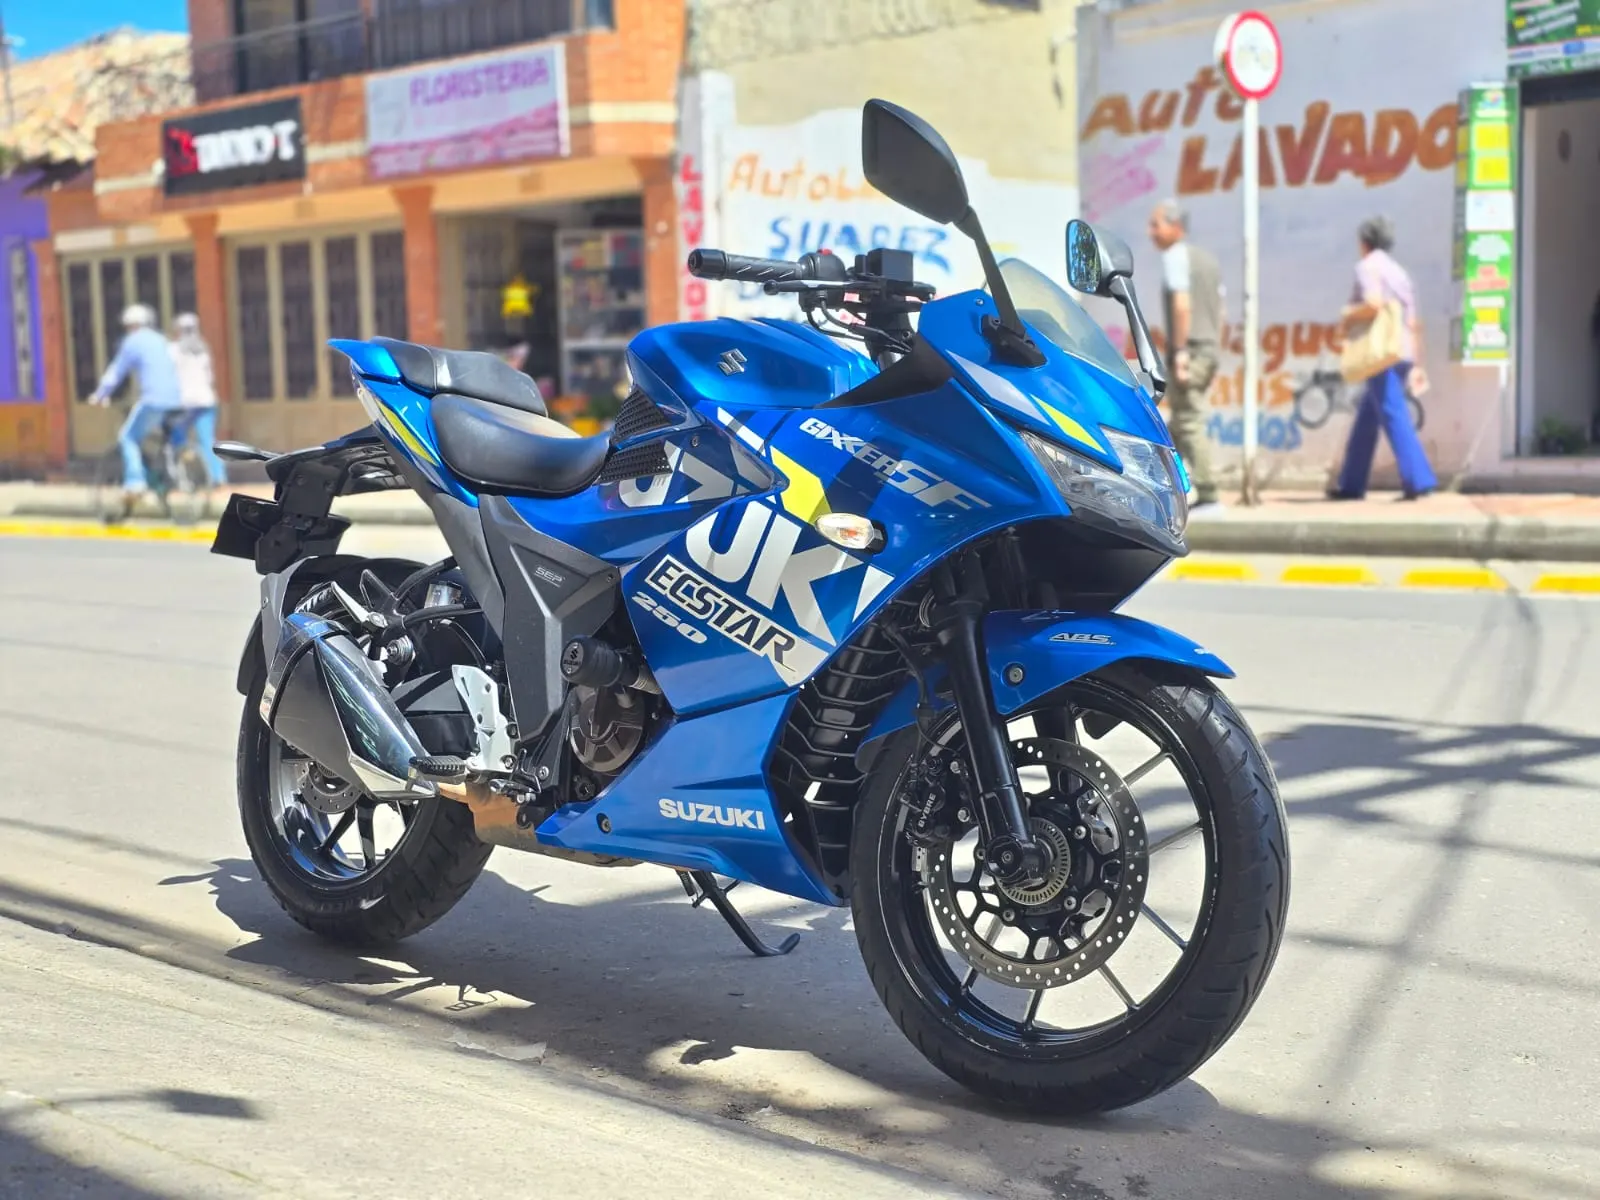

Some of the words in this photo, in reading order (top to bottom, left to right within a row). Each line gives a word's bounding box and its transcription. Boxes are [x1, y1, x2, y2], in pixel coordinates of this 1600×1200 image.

[873, 459, 993, 513] SF
[631, 590, 708, 644] 250
[648, 558, 797, 673] ECSTAR
[1048, 632, 1113, 646] ABS
[658, 798, 766, 831] SUZUKI
